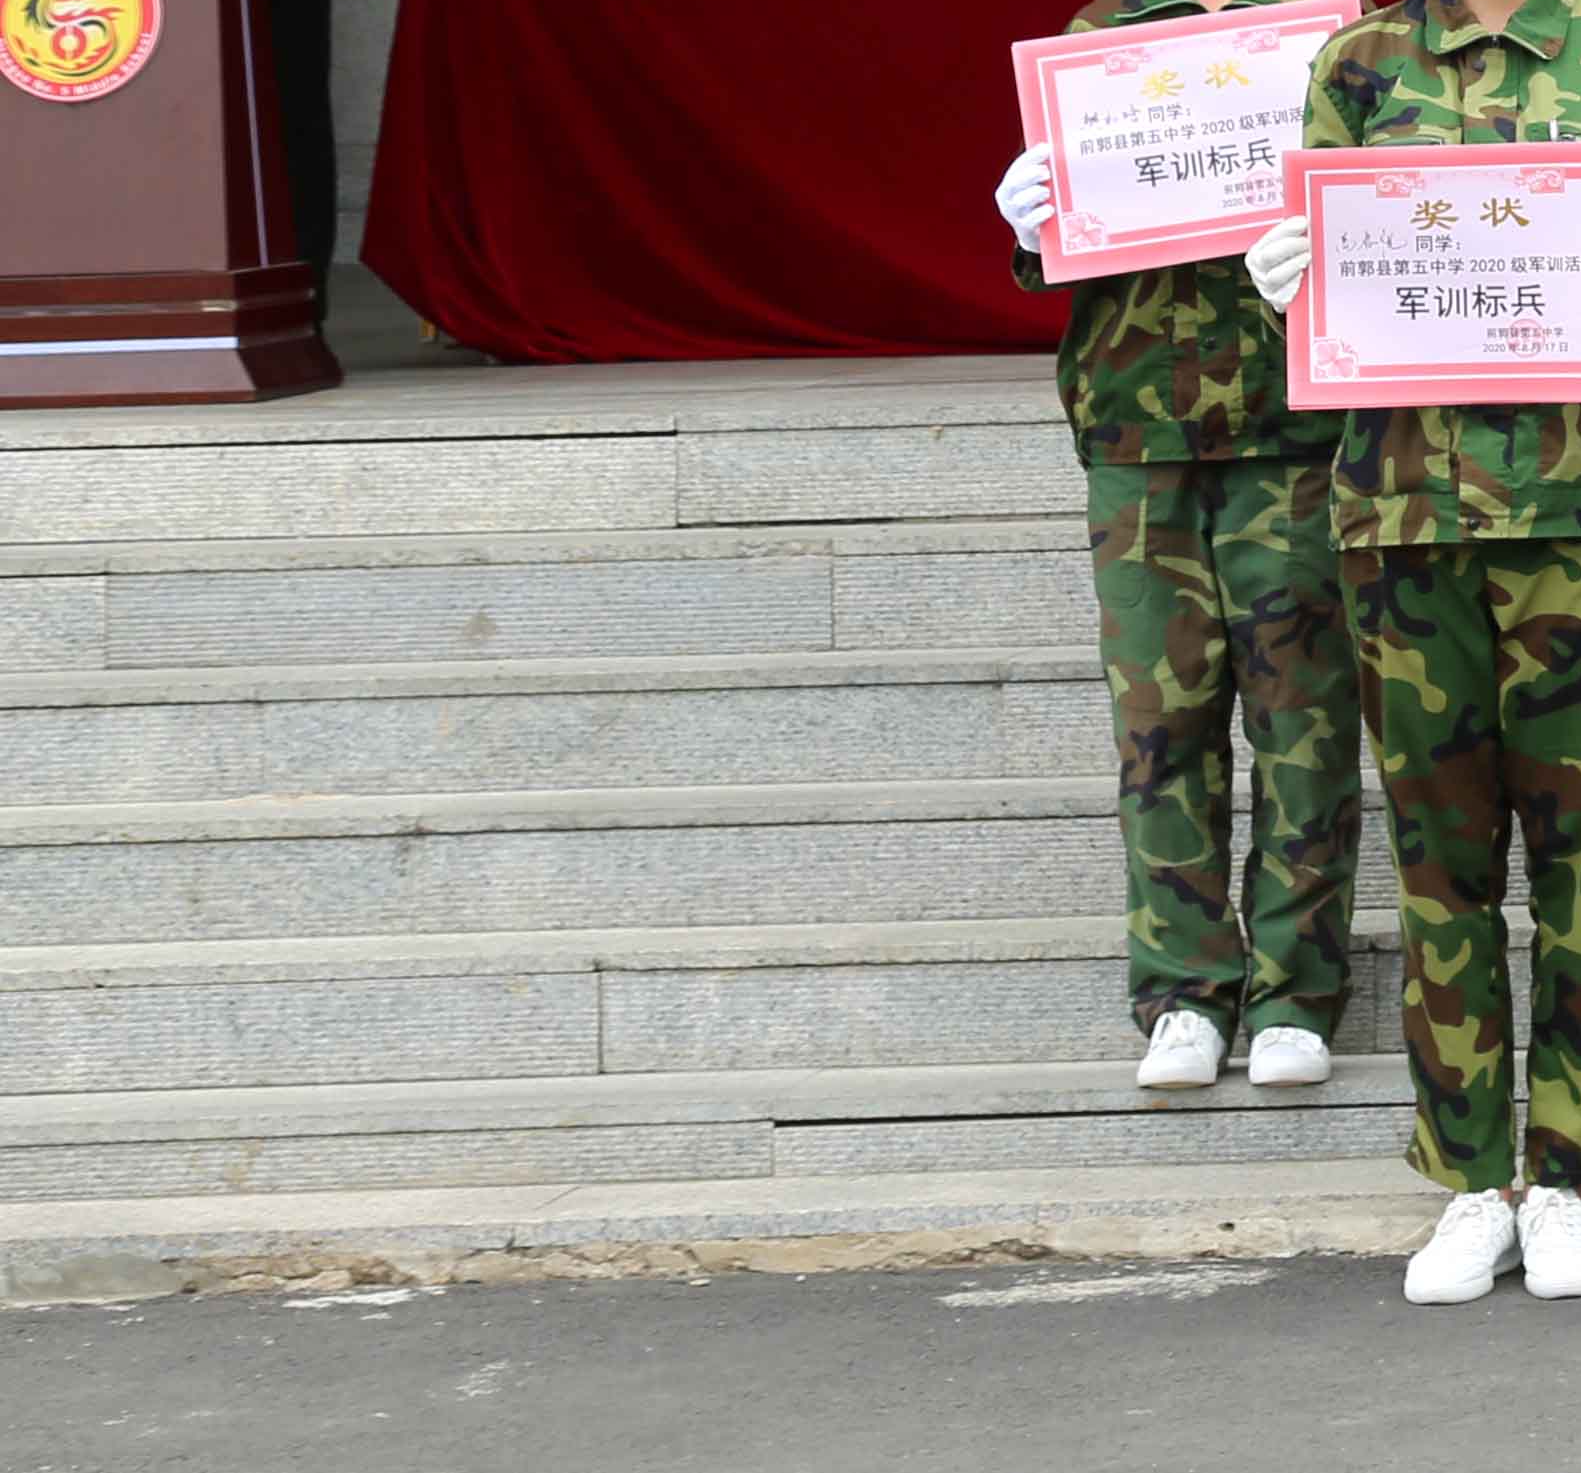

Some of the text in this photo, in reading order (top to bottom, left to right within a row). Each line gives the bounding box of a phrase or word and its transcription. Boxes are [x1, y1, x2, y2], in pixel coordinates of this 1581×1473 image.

[1140, 60, 1250, 99] 奖状
[1135, 138, 1276, 188] 军训标兵
[1410, 198, 1531, 230] 奖状
[1396, 284, 1546, 320] 军训标兵
